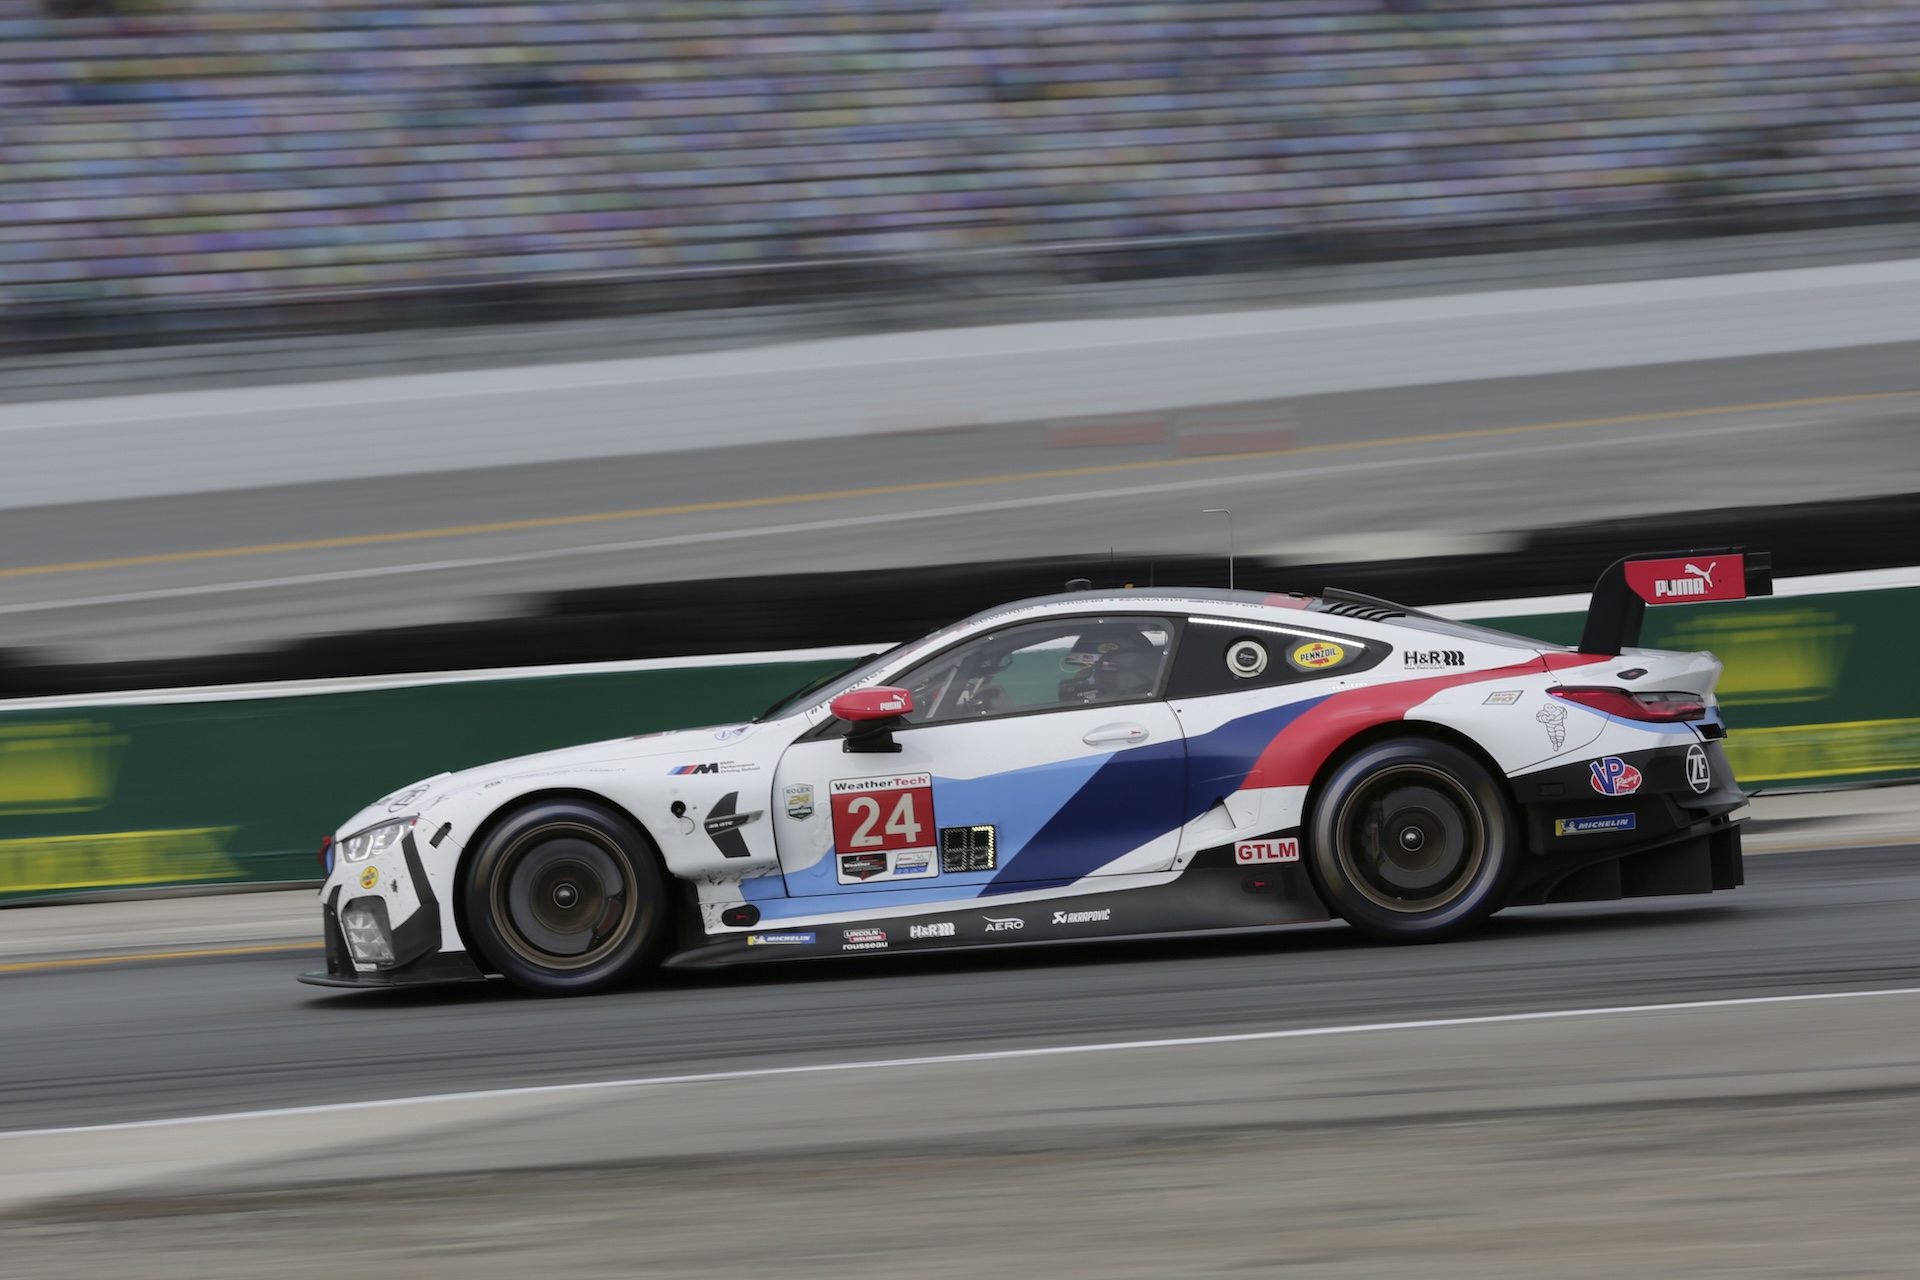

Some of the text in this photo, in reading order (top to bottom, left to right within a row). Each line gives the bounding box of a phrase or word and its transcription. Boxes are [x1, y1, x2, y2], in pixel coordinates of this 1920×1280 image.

[1655, 578, 1705, 597] PUMA
[1300, 647, 1337, 662] PENNZOIL
[1404, 650, 1442, 665] H&R
[880, 701, 902, 711] PUMA
[1590, 756, 1626, 795] VP
[1689, 754, 1709, 785] ZF
[834, 777, 926, 791] WeatherTech
[1616, 774, 1640, 788] Racing
[786, 786, 810, 795] ROLEX
[788, 794, 810, 805] 24
[847, 792, 922, 848] 24
[1578, 818, 1629, 830] MICHELIN
[1238, 842, 1297, 861] GTLM
[843, 860, 885, 869] Weather
[1068, 908, 1111, 924] AKRAPOVIČ
[910, 925, 939, 939] H&R
[985, 920, 1024, 932] AERO
[766, 934, 811, 942] MICHELIN
[844, 930, 878, 938] LINCOLN
[842, 941, 888, 951] rousseau
